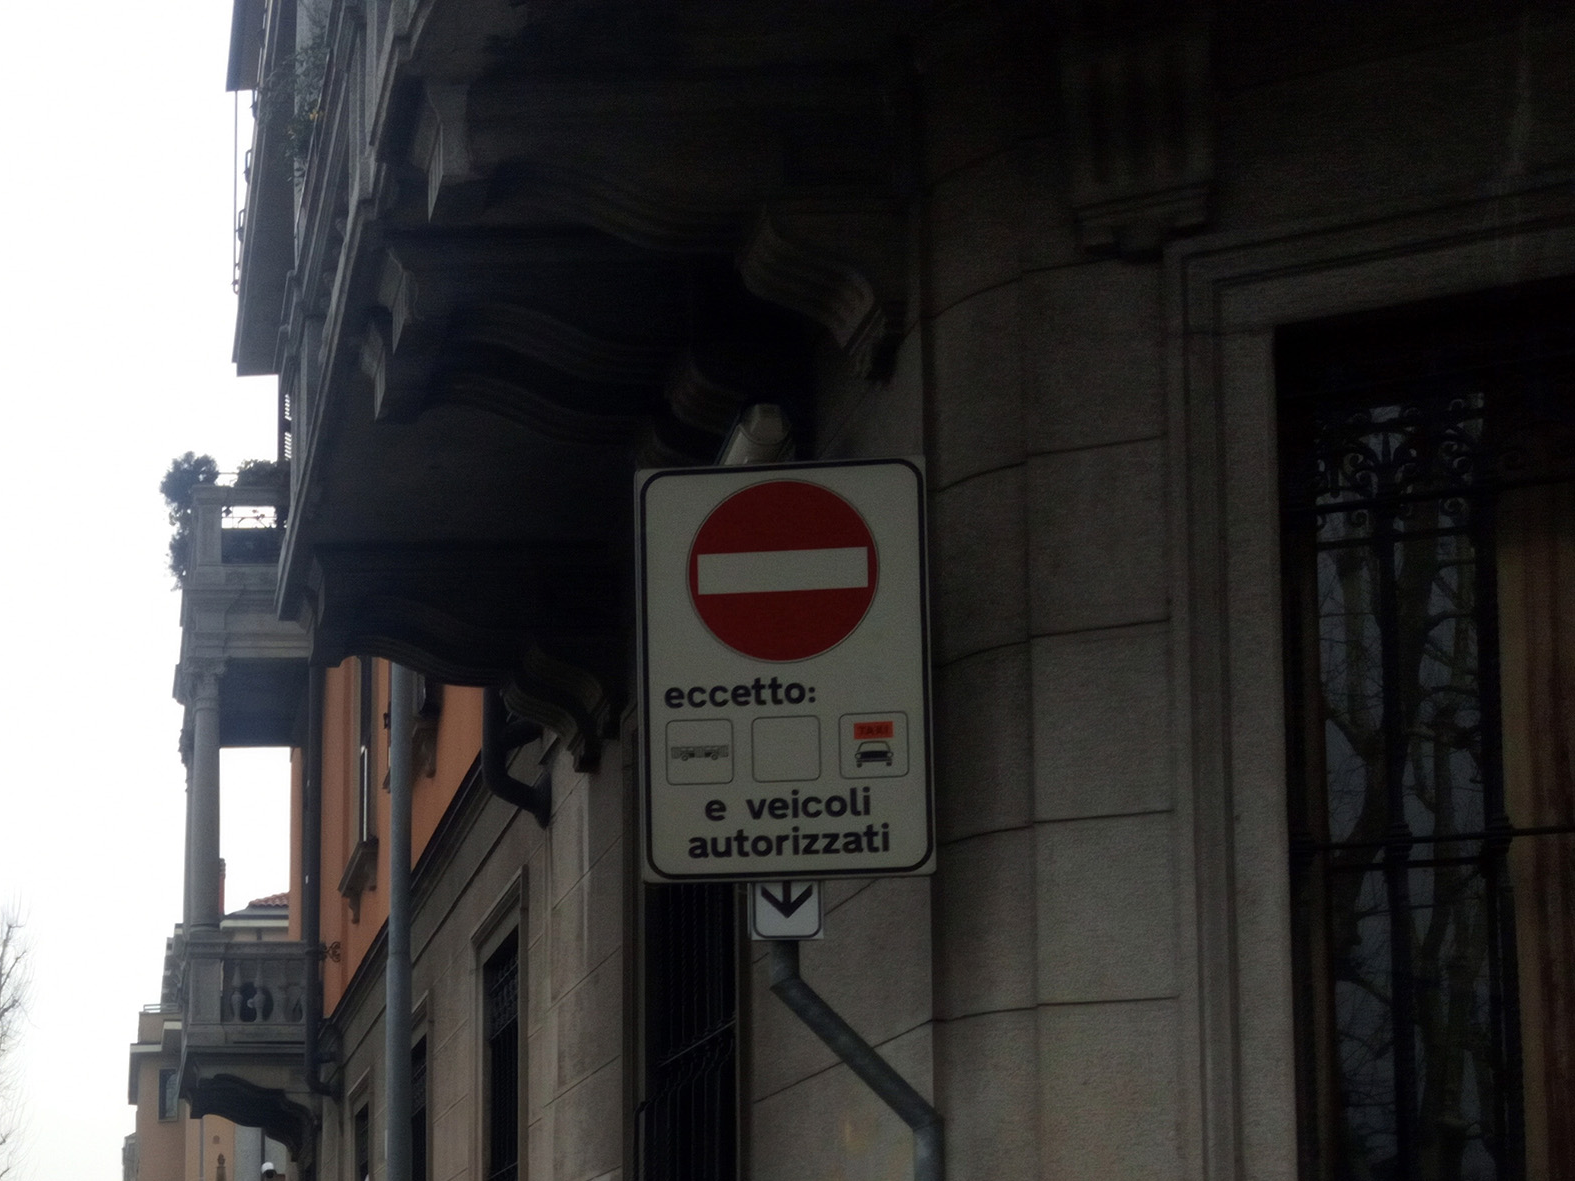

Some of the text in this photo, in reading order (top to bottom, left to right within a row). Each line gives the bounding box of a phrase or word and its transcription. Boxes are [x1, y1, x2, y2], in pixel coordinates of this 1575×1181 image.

[665, 677, 816, 709] eccetto:
[856, 724, 890, 736] TAXI
[705, 786, 871, 821] e veicoli
[688, 822, 890, 859] autorizzati
